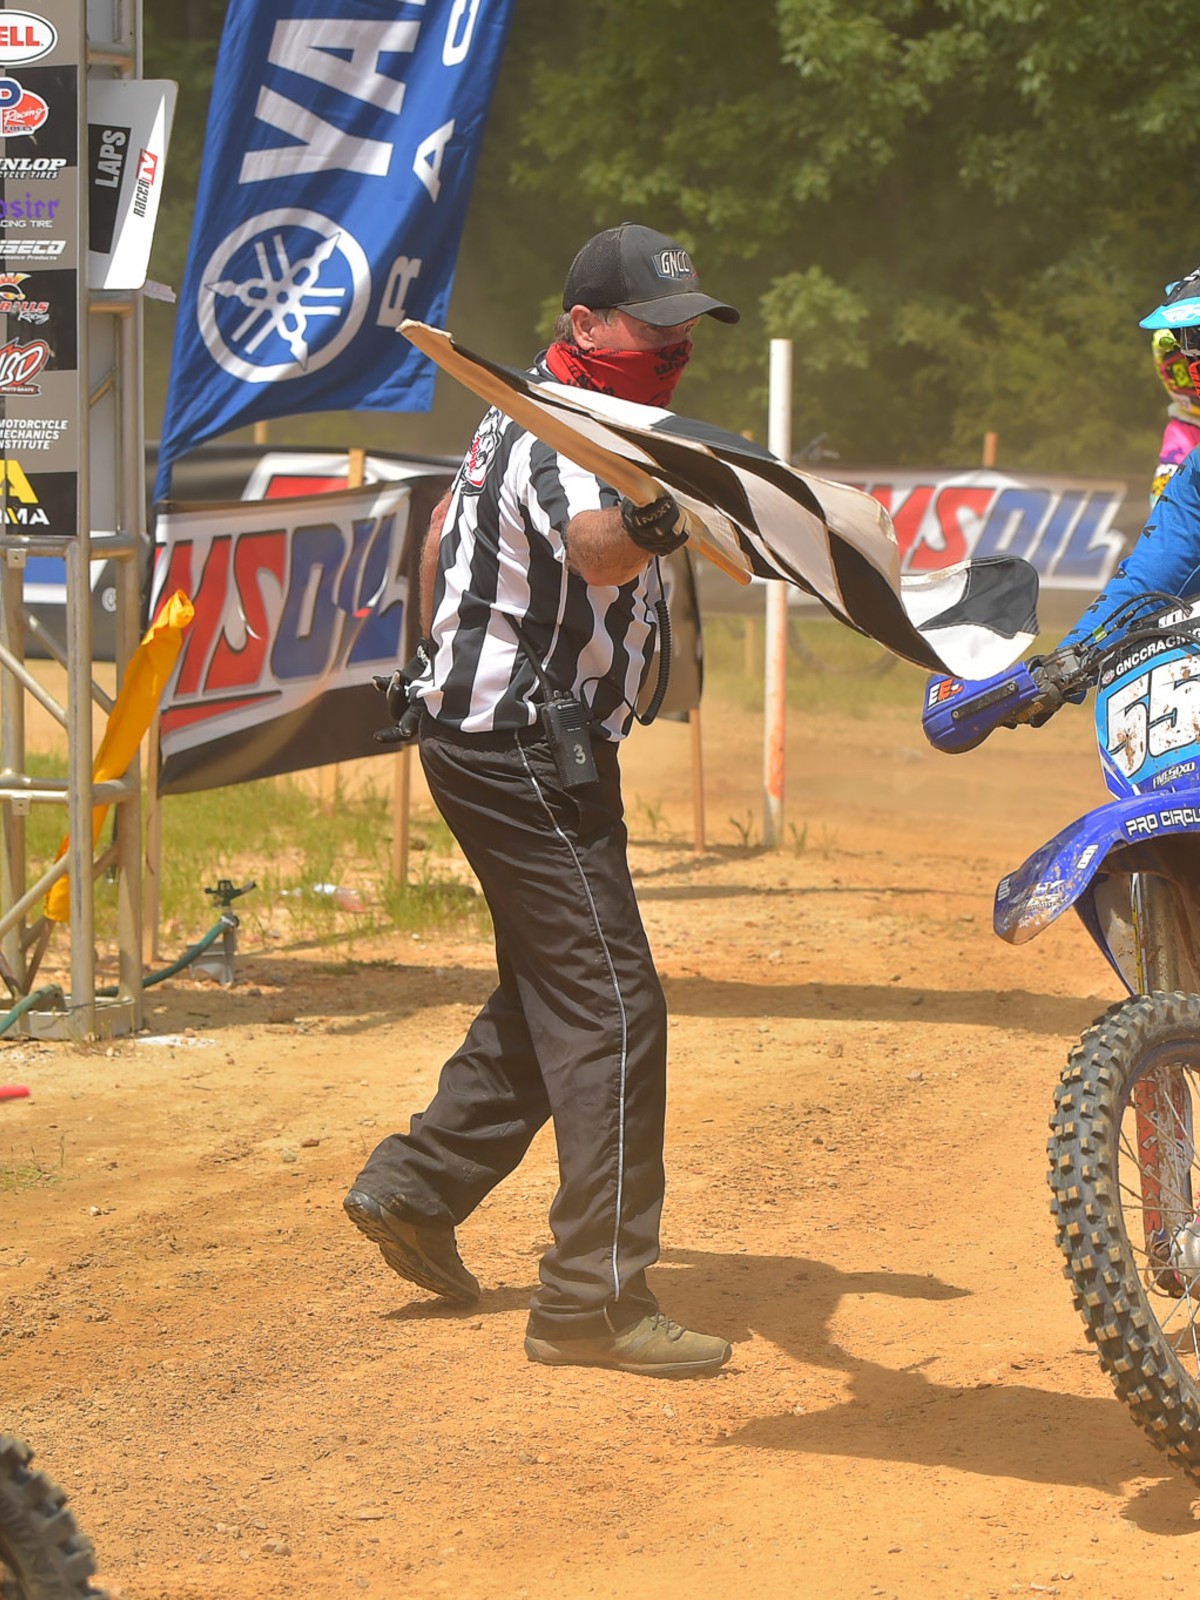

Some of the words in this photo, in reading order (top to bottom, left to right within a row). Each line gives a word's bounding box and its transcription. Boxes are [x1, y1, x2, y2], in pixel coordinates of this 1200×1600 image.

[3, 108, 47, 126] Racing
[0, 158, 67, 171] NLOP
[95, 130, 126, 188] LAPS
[30, 171, 58, 179] TIRES
[30, 220, 53, 229] TIRE
[661, 251, 690, 278] GNCC
[0, 301, 50, 313] BLLS
[0, 508, 51, 526] MA
[573, 744, 587, 765] 3
[1125, 813, 1159, 836] PRO
